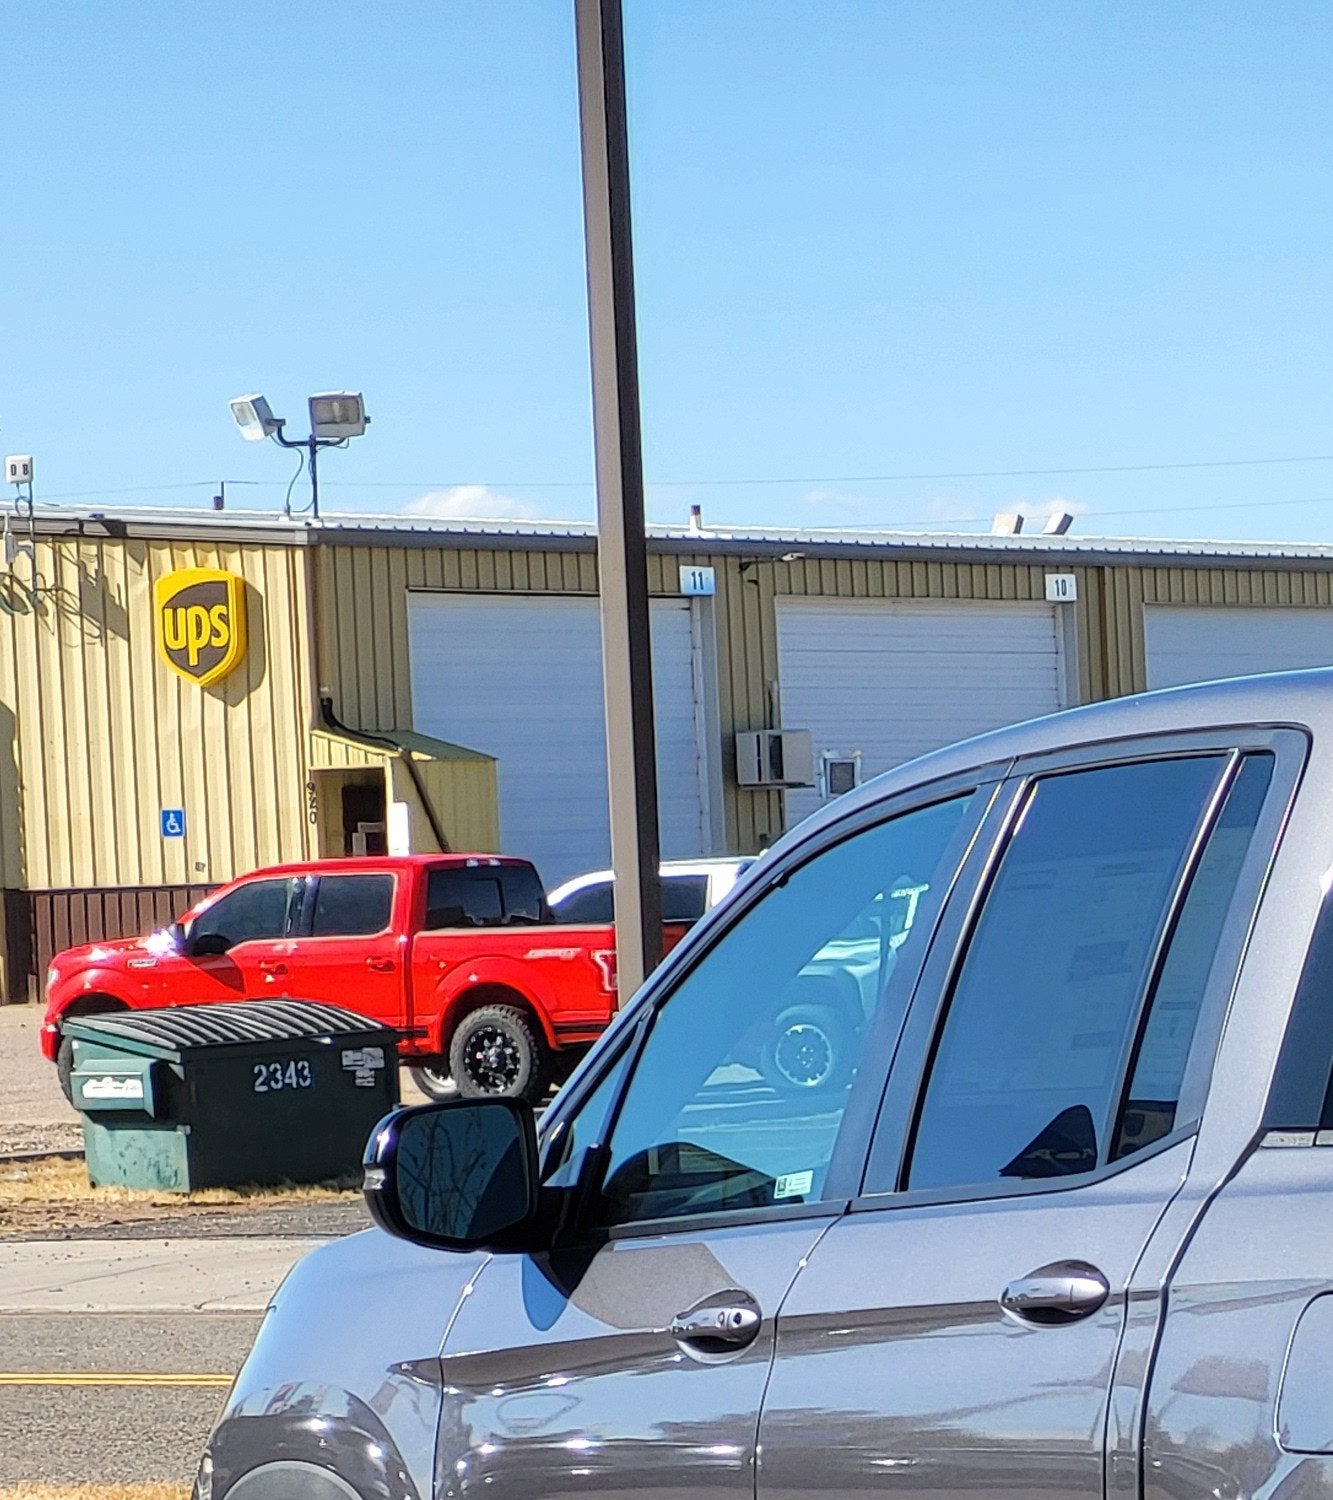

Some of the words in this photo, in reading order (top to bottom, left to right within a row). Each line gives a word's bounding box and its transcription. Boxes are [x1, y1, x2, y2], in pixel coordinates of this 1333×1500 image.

[691, 570, 704, 590] 11
[1055, 578, 1067, 597] 10
[253, 1059, 312, 1093] 2343
